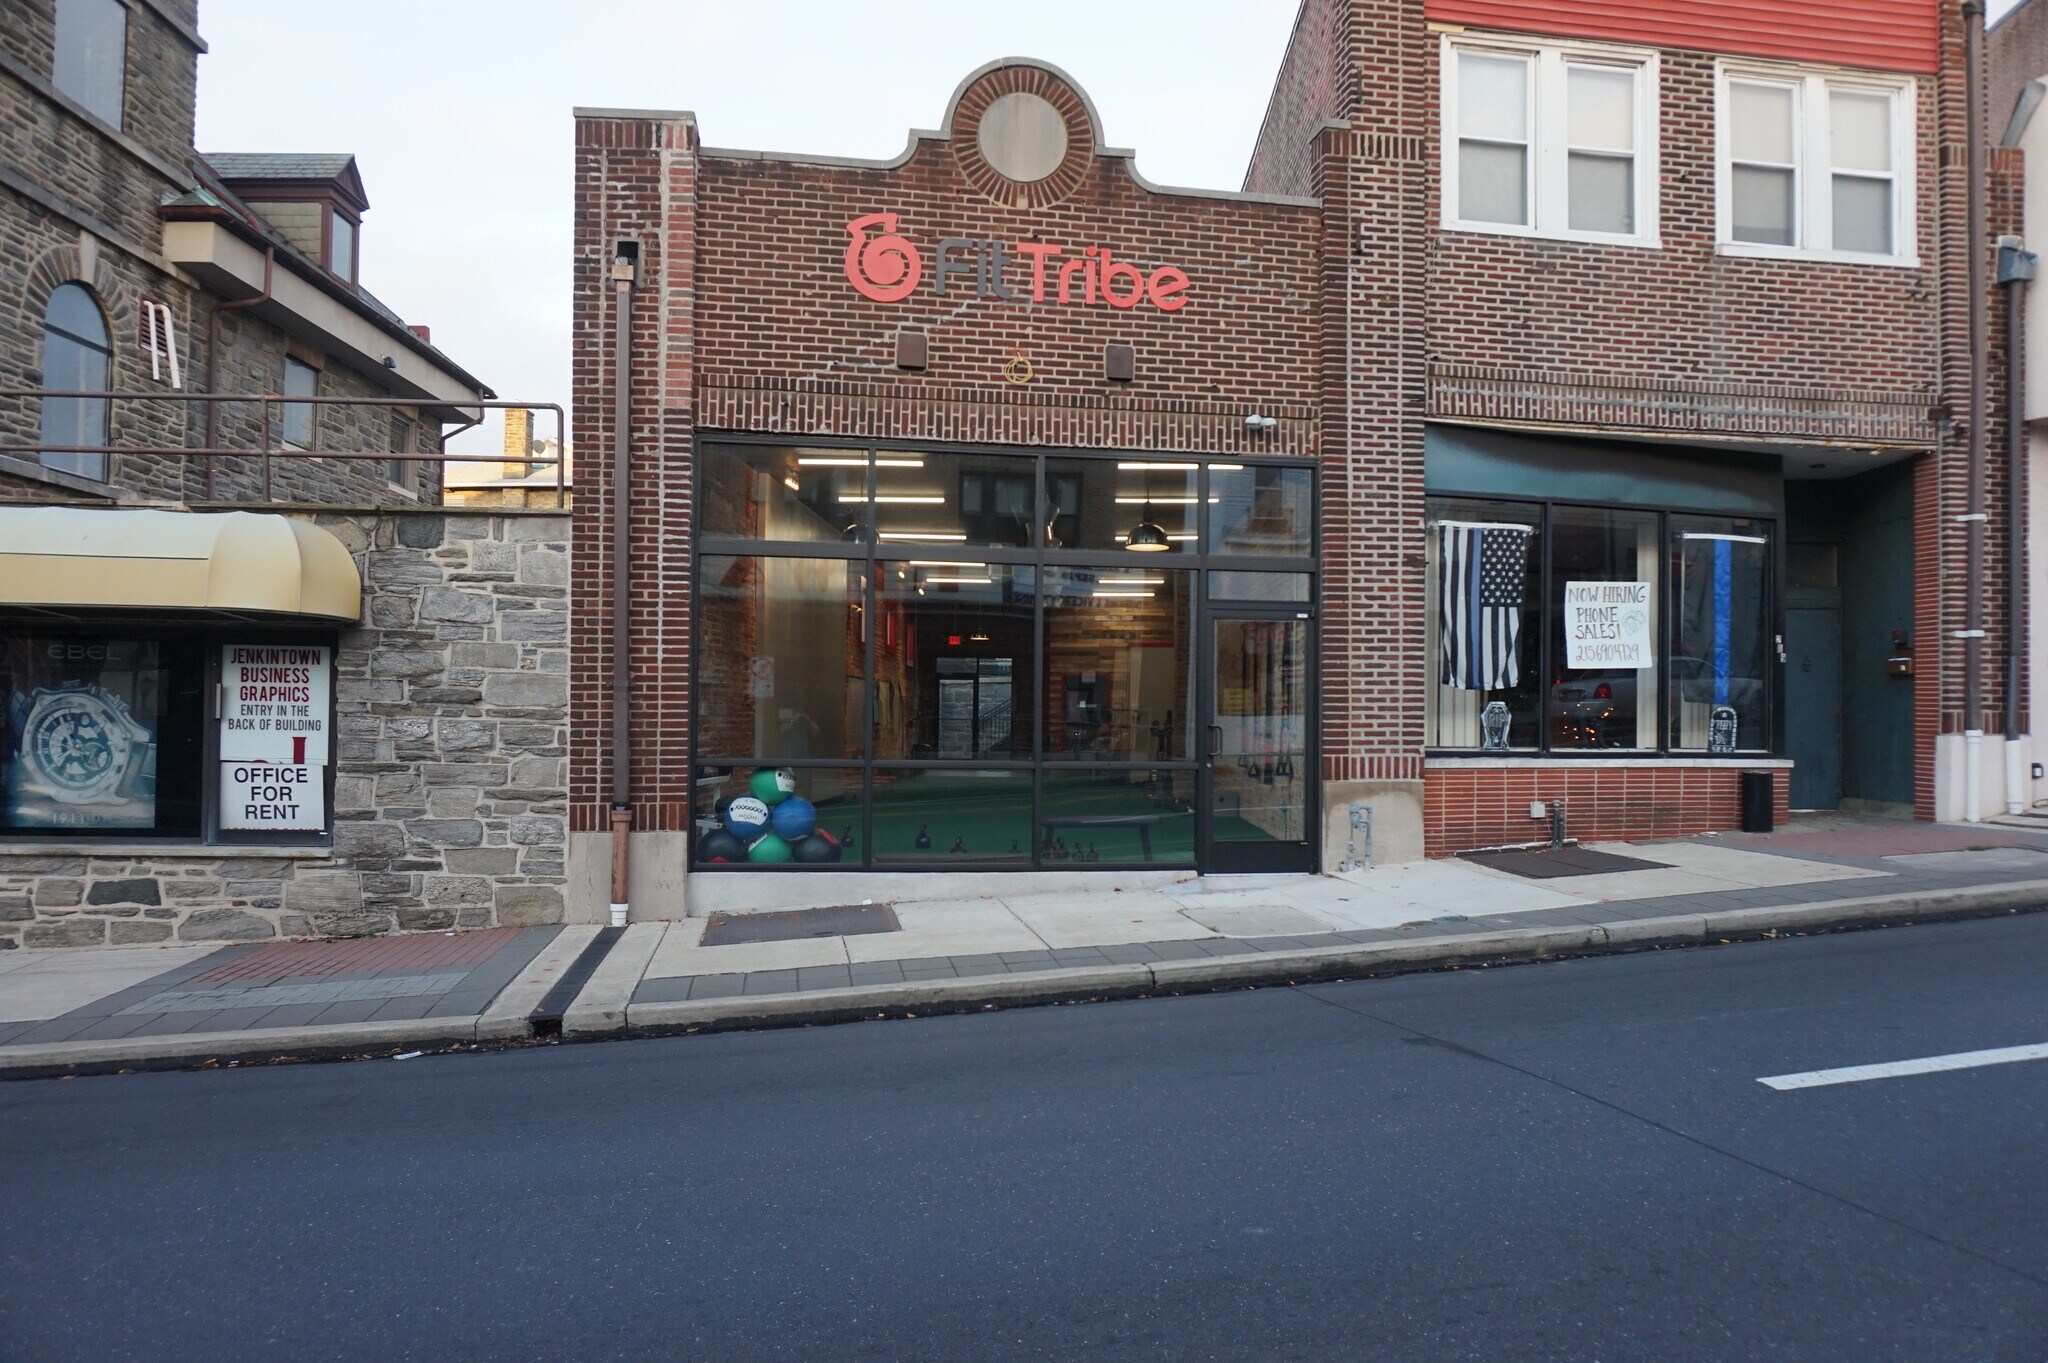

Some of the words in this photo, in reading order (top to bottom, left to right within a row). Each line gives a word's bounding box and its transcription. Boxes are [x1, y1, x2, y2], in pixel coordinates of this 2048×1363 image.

[935, 238, 1190, 311] FitTribe
[1568, 586, 1599, 602] NOW
[1603, 585, 1645, 603] HIRING
[1576, 606, 1619, 623] PHONE
[1575, 623, 1621, 639] SALES!
[47, 643, 122, 660] EBEL
[230, 648, 321, 665] JENKINTOWN
[240, 667, 309, 684] BUSINESS
[240, 686, 309, 702] GRAPHICS
[240, 704, 273, 716] ENTRY
[277, 705, 287, 716] IN
[291, 705, 309, 717] THE
[228, 718, 255, 730] BACK
[259, 718, 272, 731] OF
[275, 719, 321, 731] BUILDING
[234, 767, 308, 783] OFFICE
[251, 786, 292, 802] FOR
[245, 804, 300, 820] RENT
